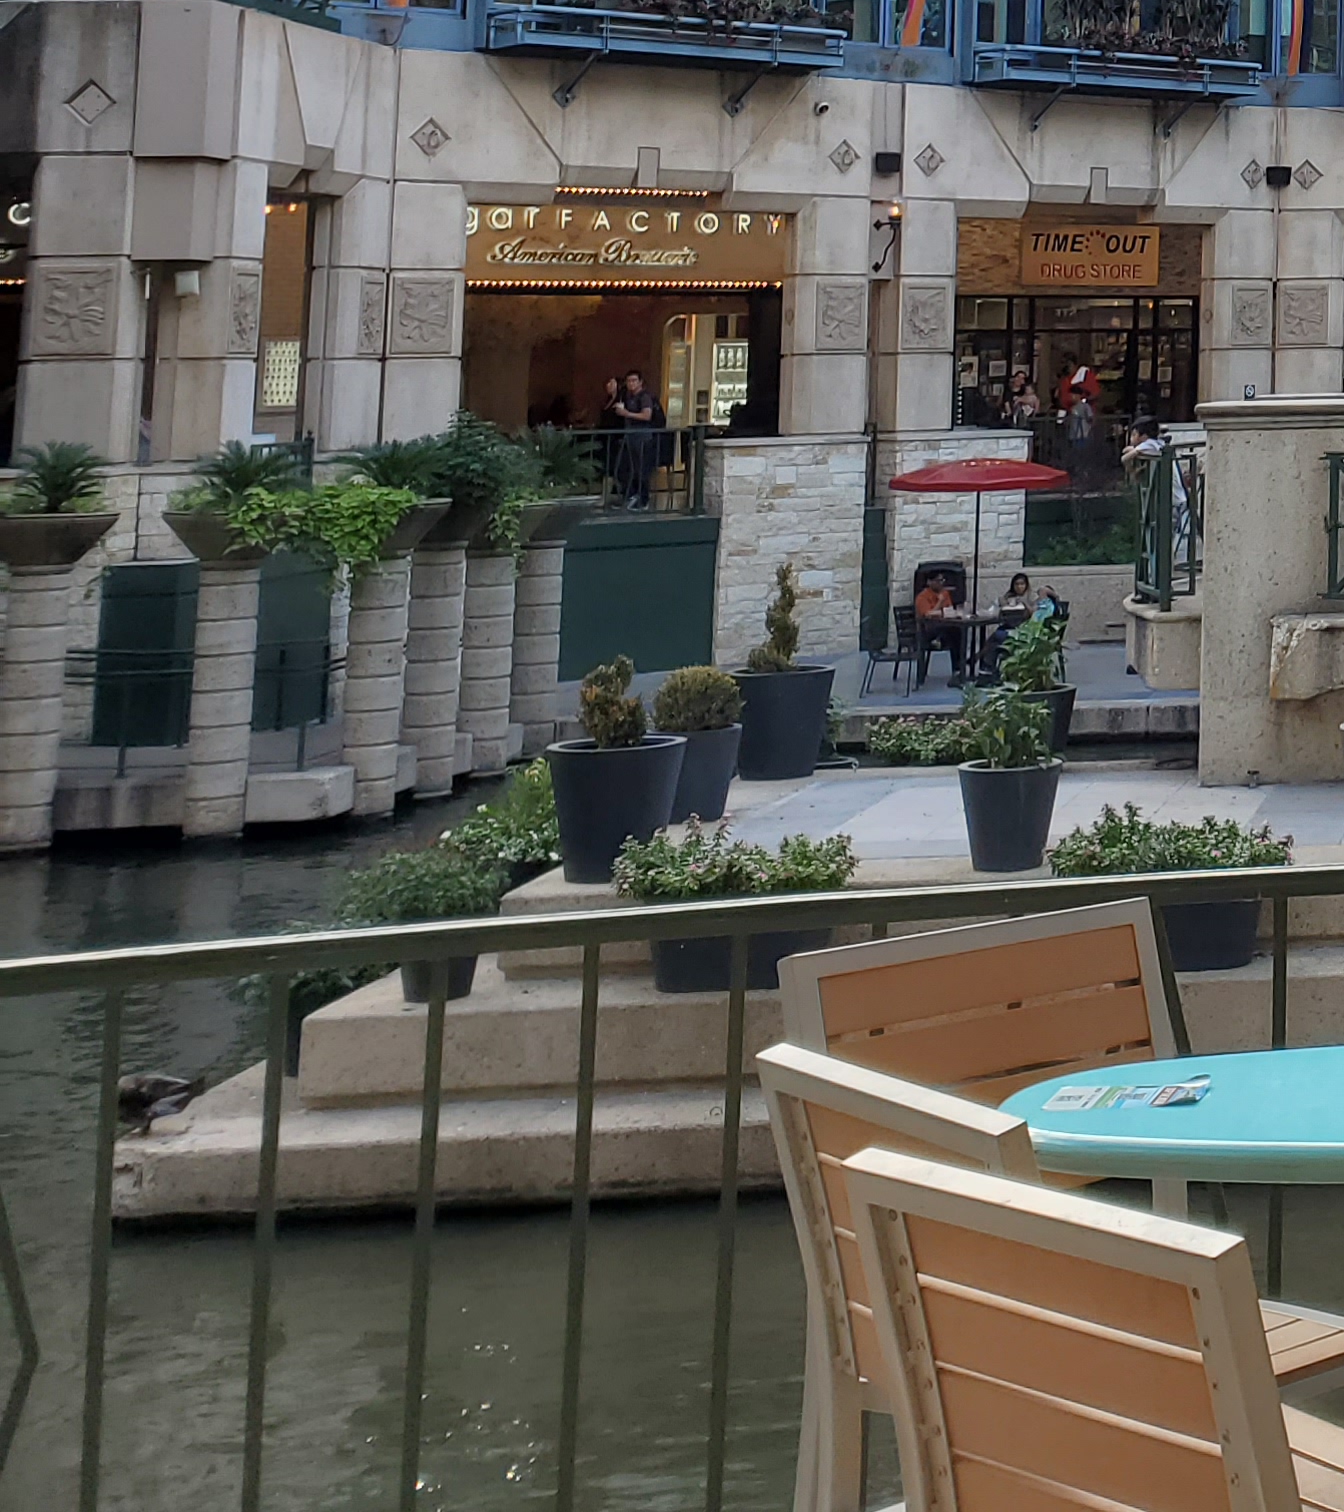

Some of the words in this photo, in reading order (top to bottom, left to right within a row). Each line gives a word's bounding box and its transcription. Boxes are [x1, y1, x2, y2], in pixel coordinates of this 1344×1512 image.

[558, 208, 785, 234] FACTORY
[1031, 233, 1086, 253] TIME
[1105, 234, 1152, 254] OUT
[1040, 263, 1086, 279] DRUG
[1089, 263, 1143, 280] STORE
